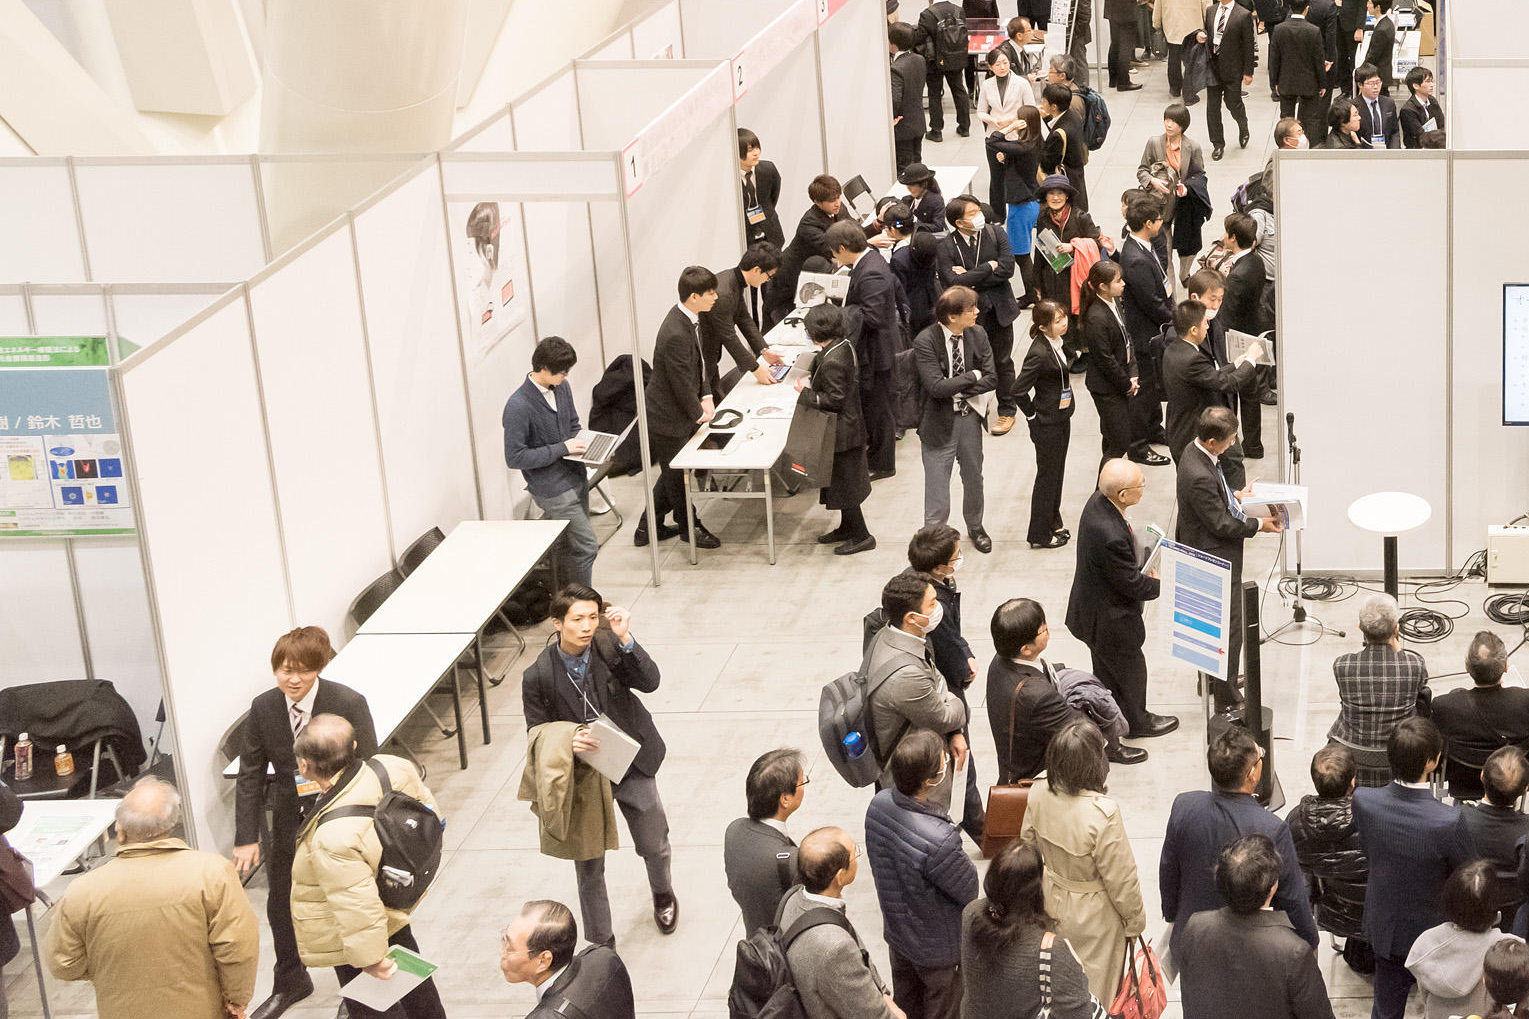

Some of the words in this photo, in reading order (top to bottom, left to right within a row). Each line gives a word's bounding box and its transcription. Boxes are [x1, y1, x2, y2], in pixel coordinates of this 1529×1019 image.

[736, 64, 744, 86] 2
[630, 154, 637, 178] 1
[27, 414, 62, 430] 鈴木
[68, 414, 103, 429] 哲也
